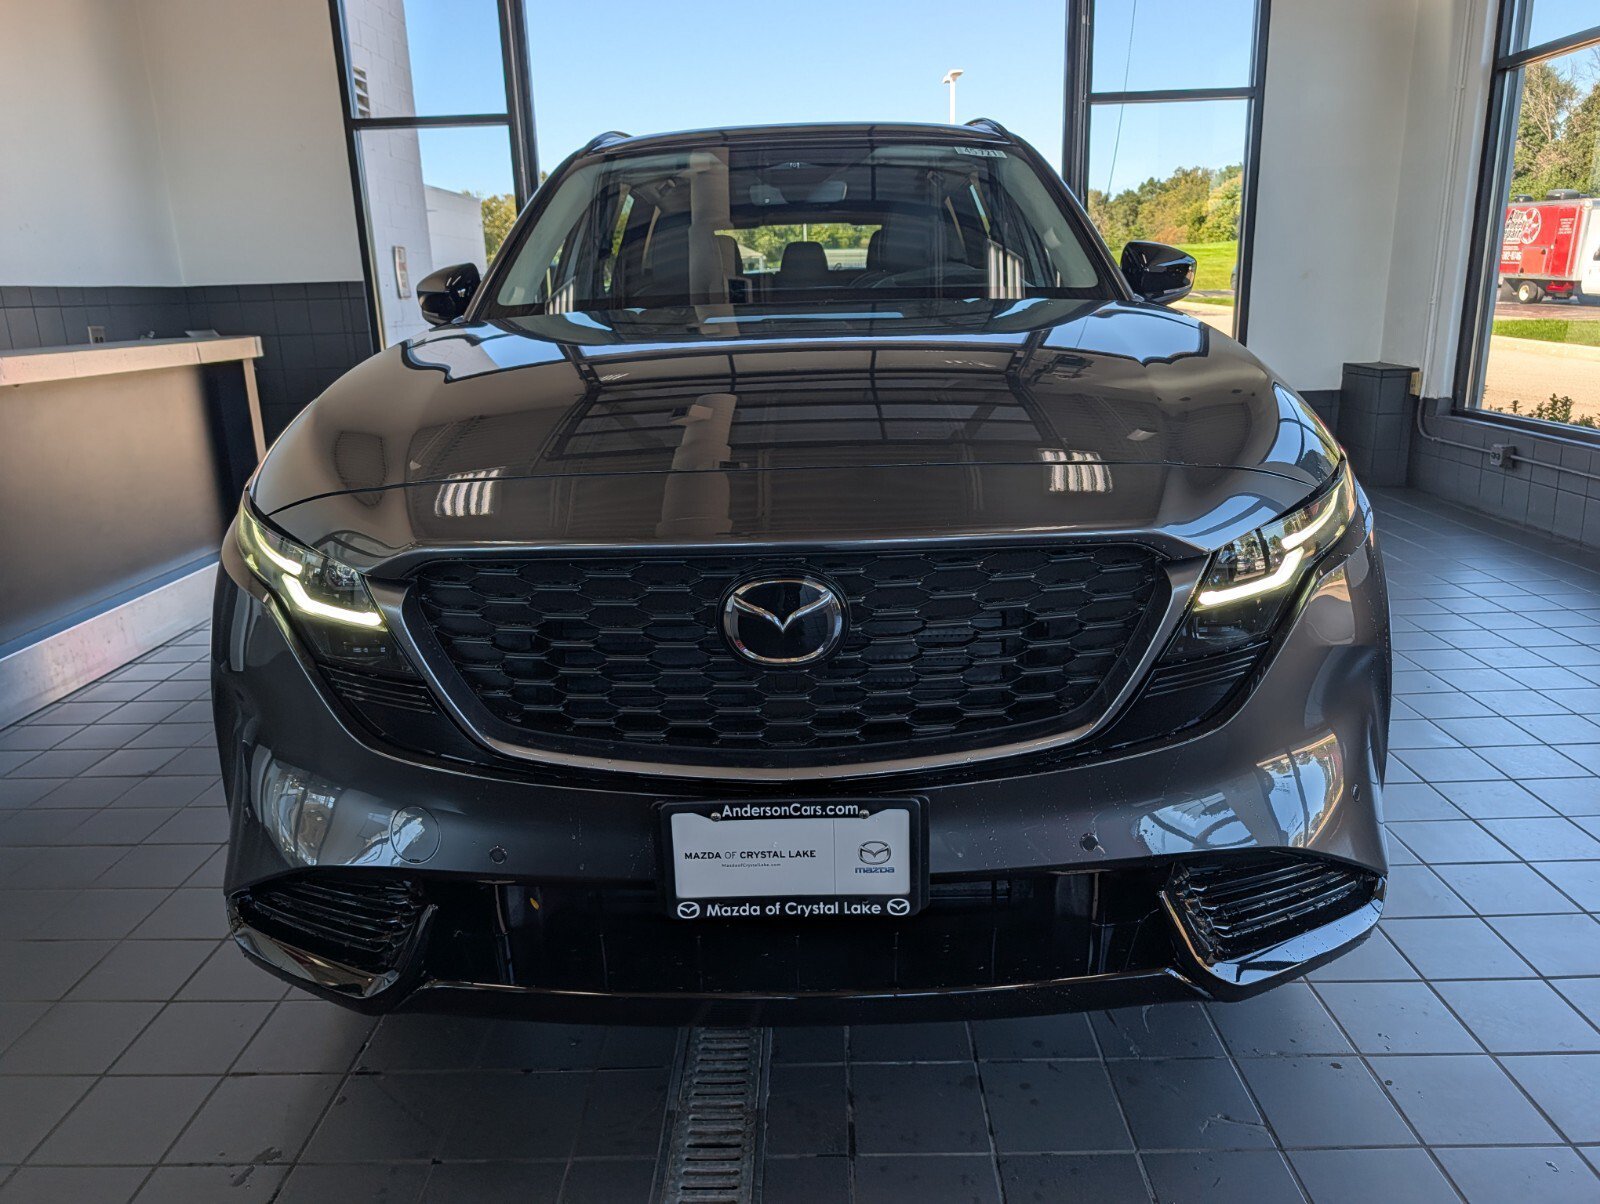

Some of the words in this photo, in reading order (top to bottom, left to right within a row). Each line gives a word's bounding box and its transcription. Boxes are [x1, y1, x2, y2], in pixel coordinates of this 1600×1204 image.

[722, 803, 859, 818] AndersonCars.com
[684, 851, 722, 860] MAZDA
[724, 851, 737, 860] OF
[739, 850, 786, 859] CRYSTAL
[788, 849, 817, 858] LAKE
[706, 903, 761, 917] Mazda
[765, 902, 781, 915] of
[785, 901, 839, 917] Crystal
[844, 901, 882, 915] Lake
